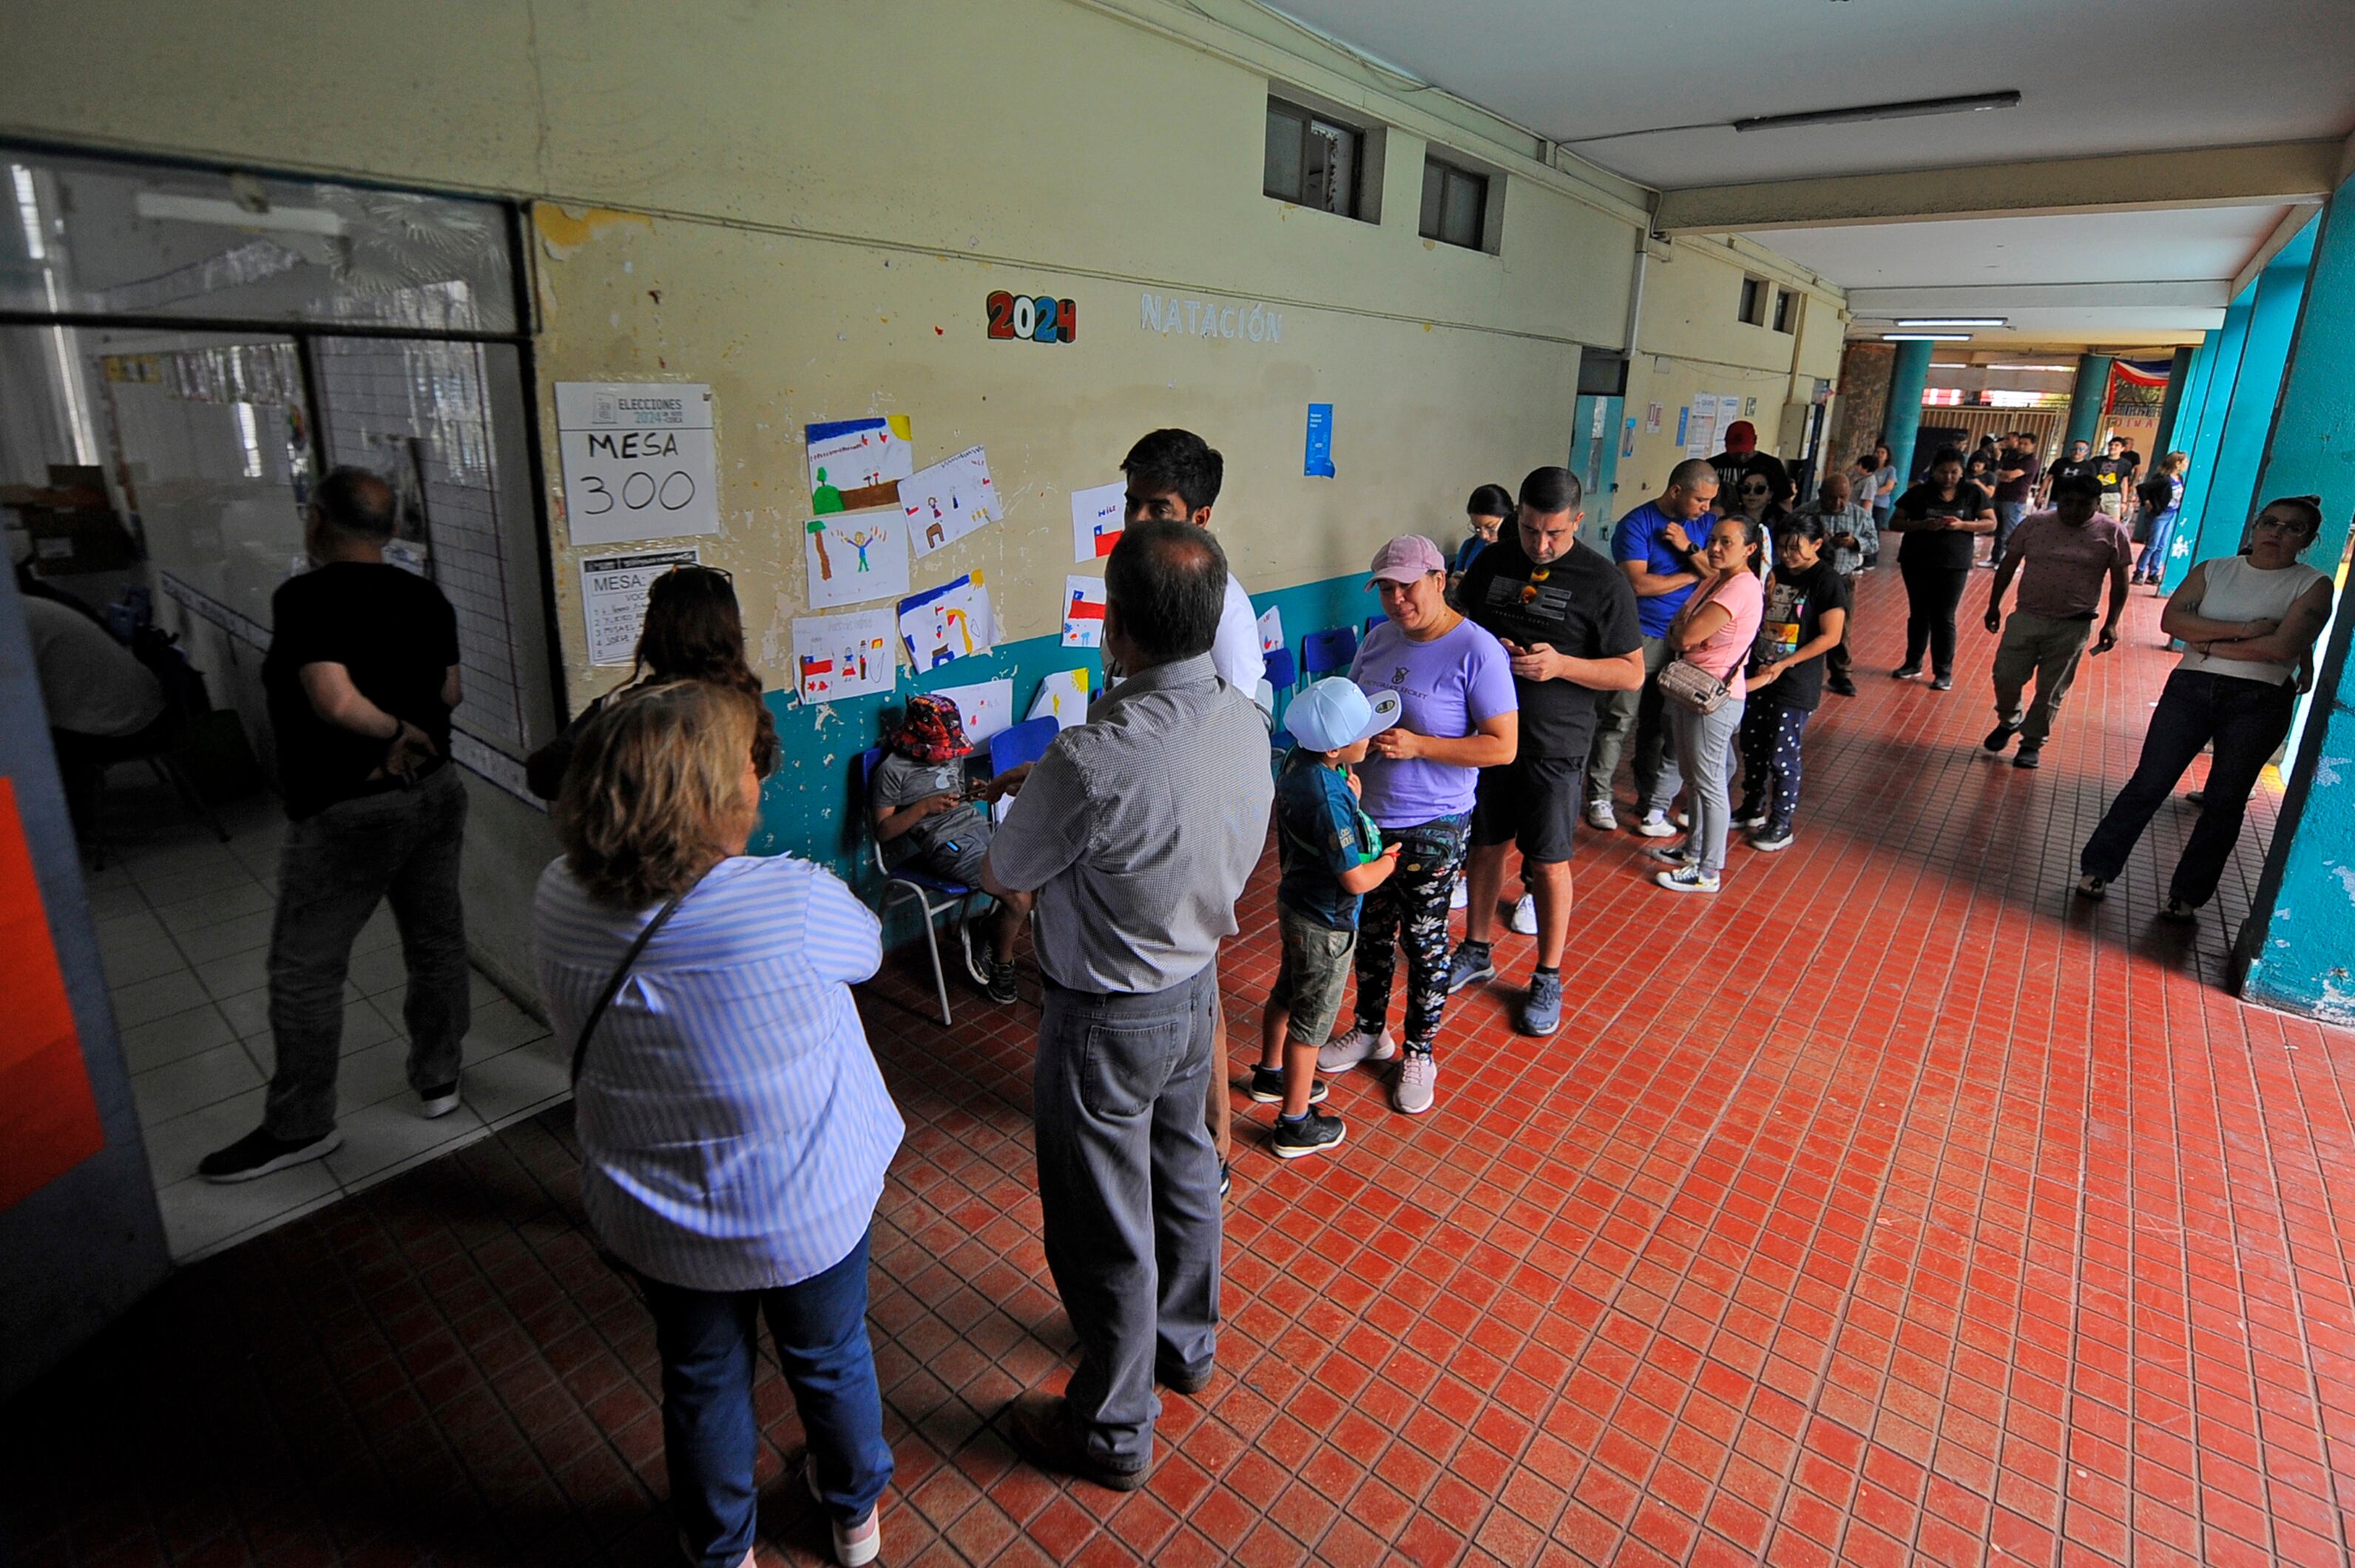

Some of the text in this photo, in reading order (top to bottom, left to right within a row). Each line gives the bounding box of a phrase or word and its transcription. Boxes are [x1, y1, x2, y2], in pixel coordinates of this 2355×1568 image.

[986, 290, 1077, 343] 2024
[1141, 294, 1283, 344] NATACIÓN
[618, 398, 682, 410] ELECCIONES
[587, 432, 679, 459] MESA
[580, 470, 695, 515] 300
[594, 575, 646, 592] MESA:
